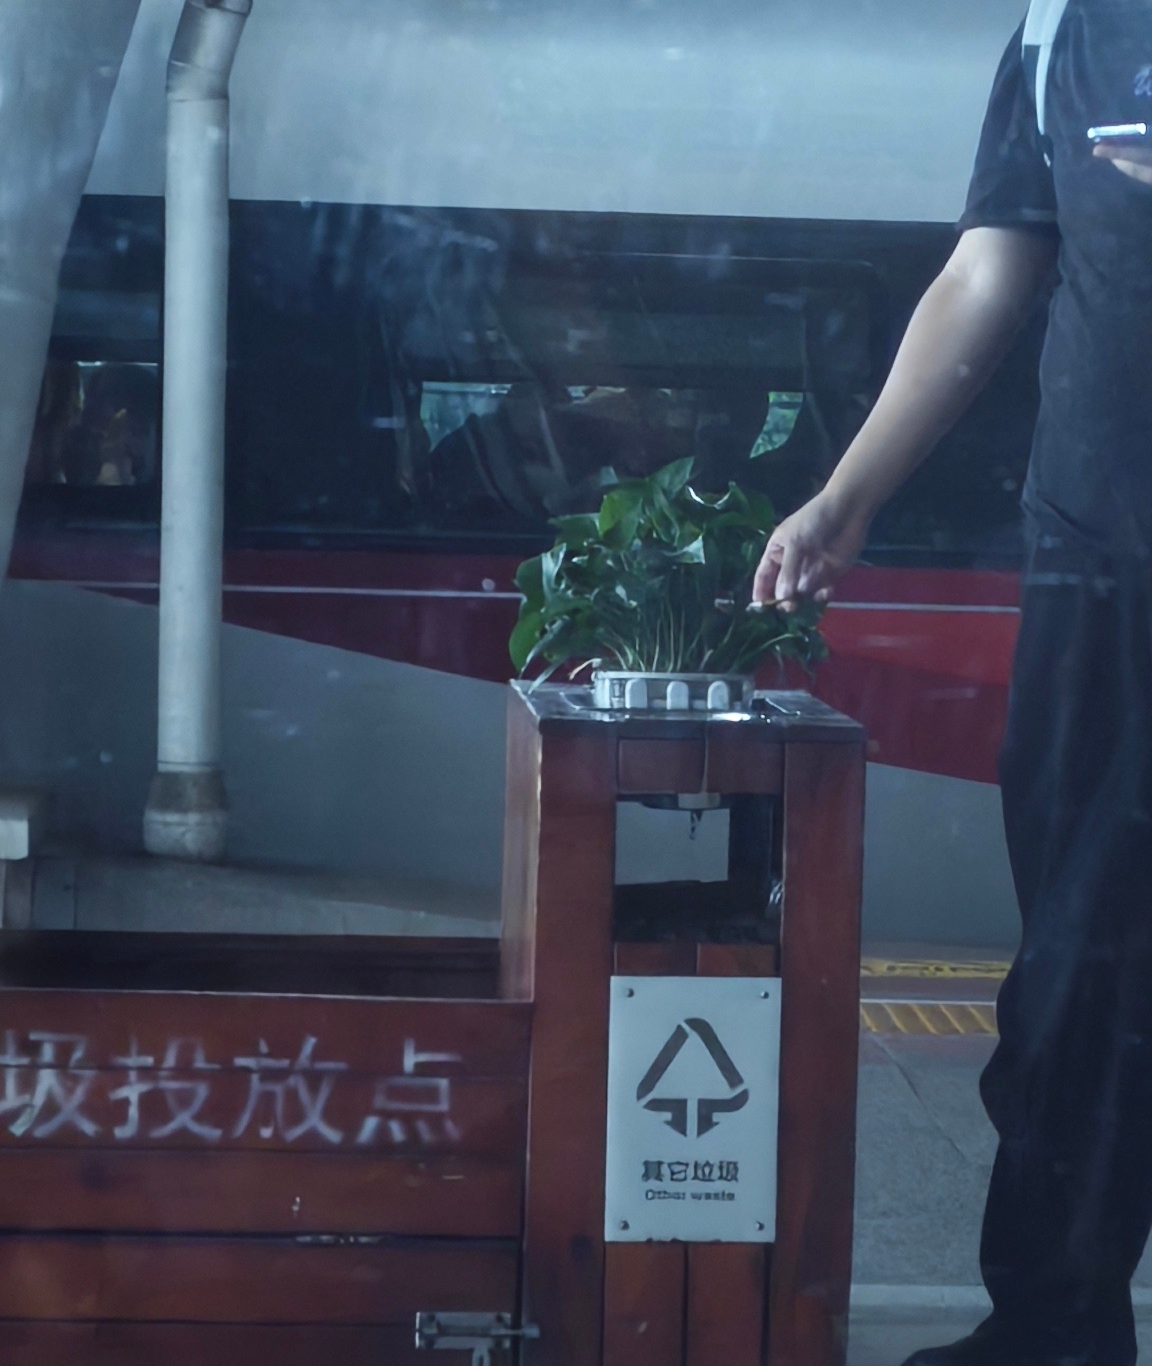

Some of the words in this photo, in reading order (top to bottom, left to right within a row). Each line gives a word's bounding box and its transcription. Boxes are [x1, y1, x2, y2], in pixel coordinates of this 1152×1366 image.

[641, 1160, 738, 1183] 其它垃圾
[645, 1189, 686, 1201] Other
[691, 1191, 735, 1202] waste
